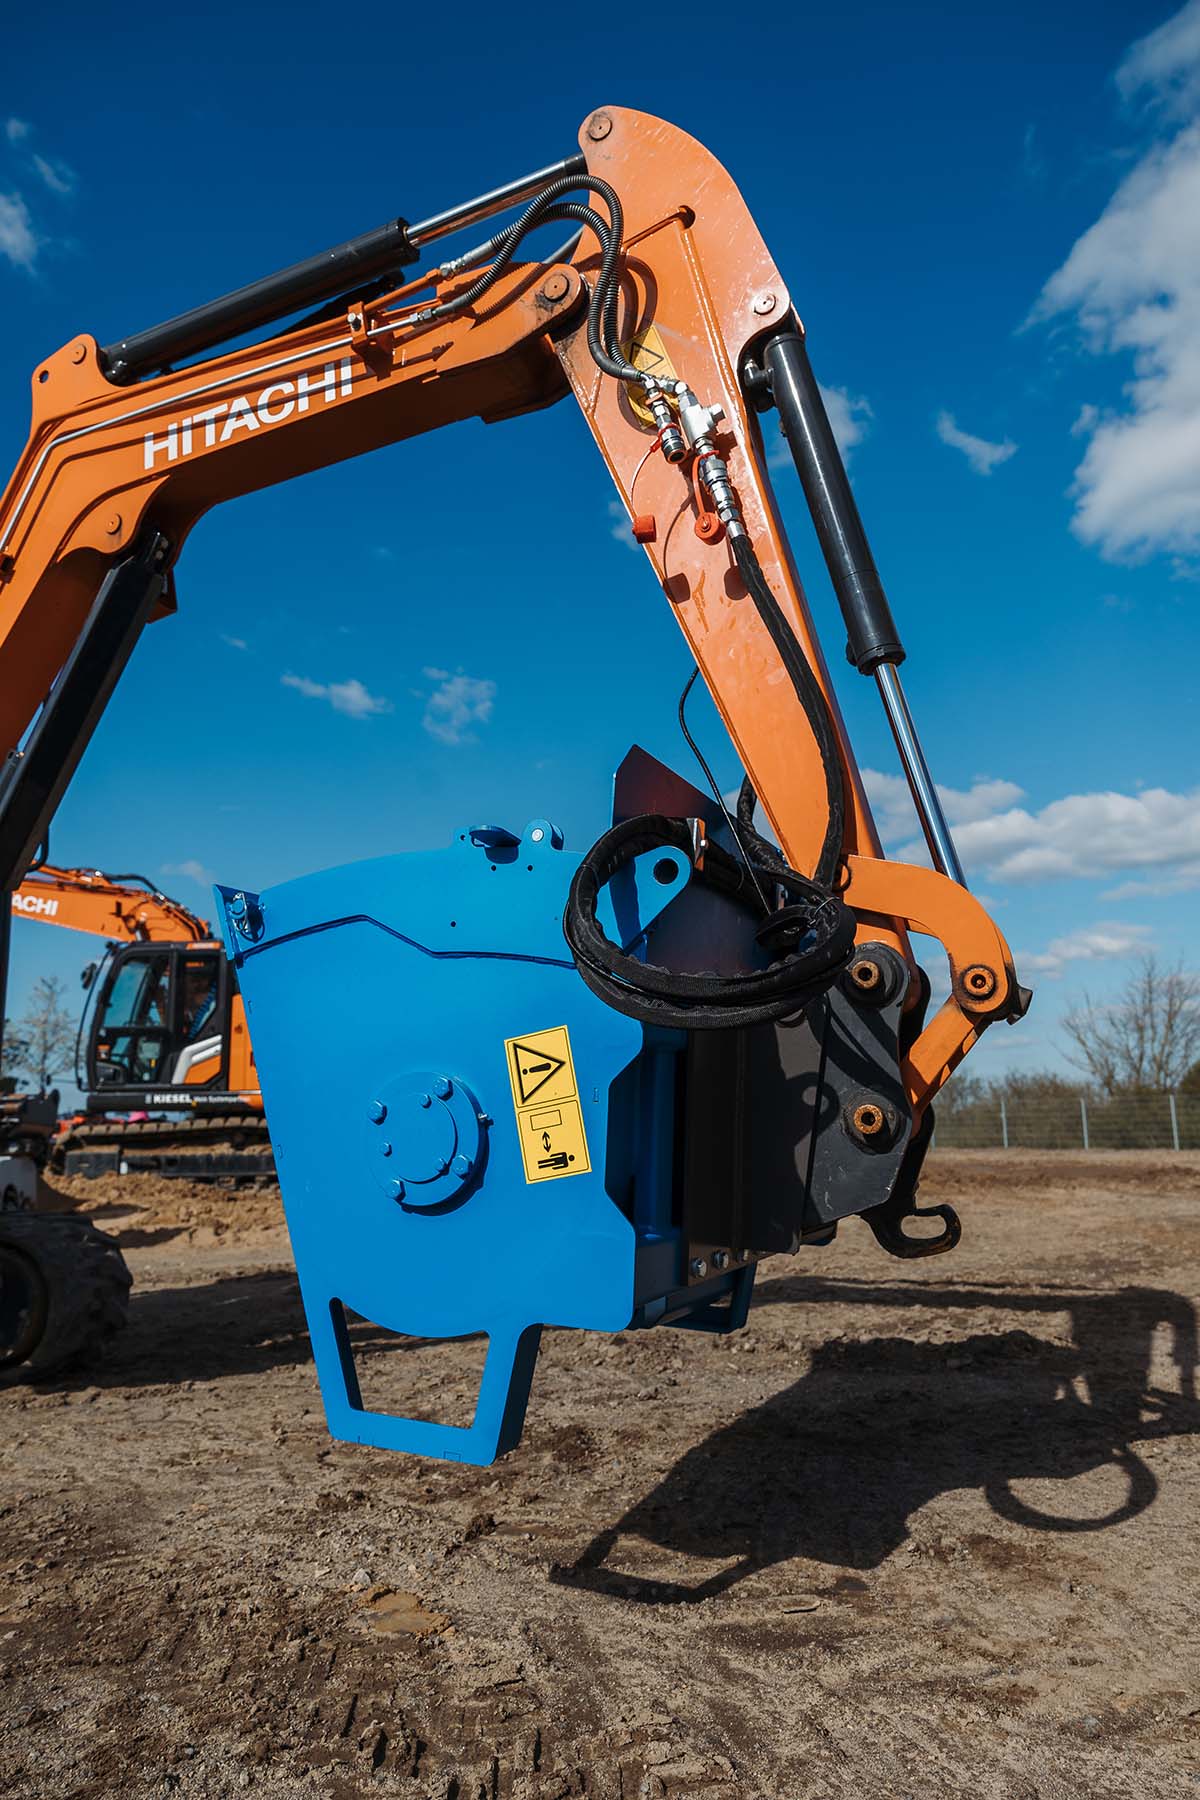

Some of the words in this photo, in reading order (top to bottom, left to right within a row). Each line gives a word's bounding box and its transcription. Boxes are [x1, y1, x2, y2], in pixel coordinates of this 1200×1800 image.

[143, 357, 353, 470] HITACHI
[12, 893, 59, 916] ACHI
[153, 1093, 192, 1104] KIESEL
